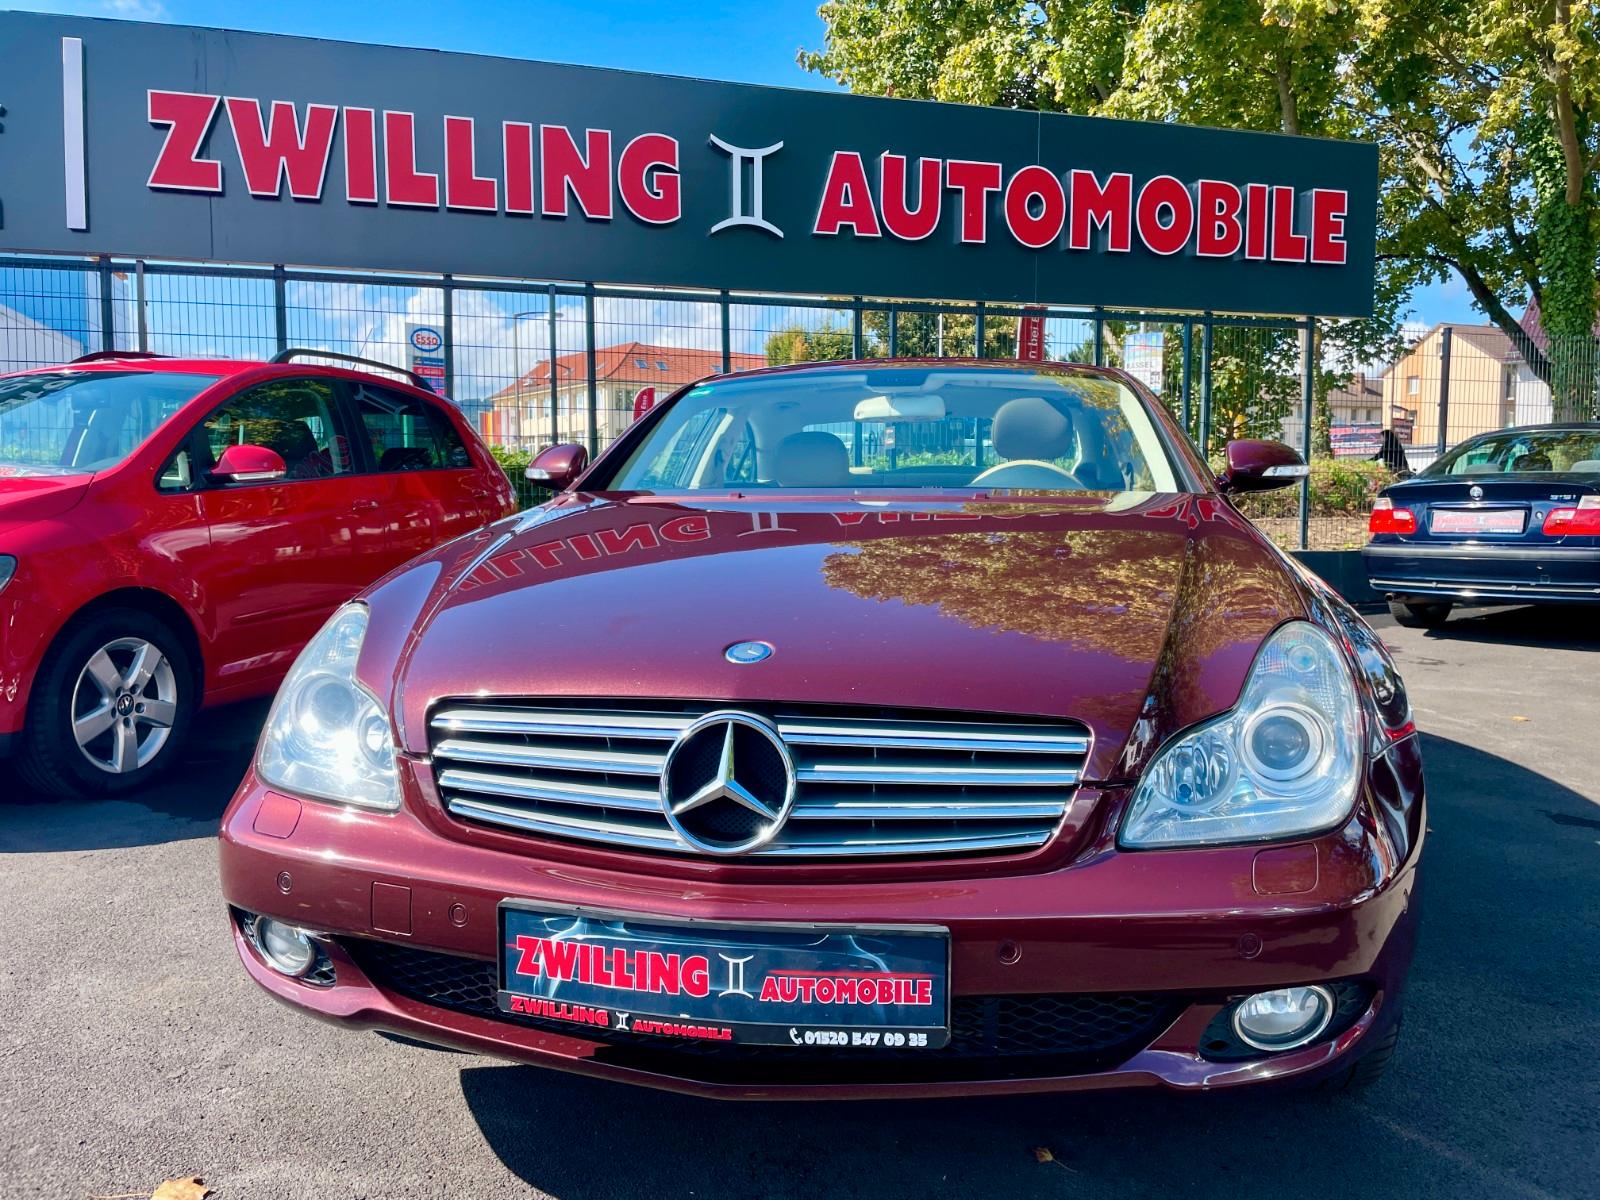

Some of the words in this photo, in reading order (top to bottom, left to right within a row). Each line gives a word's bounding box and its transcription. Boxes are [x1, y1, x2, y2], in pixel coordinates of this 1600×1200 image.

[146, 88, 682, 225] ZWILLING
[812, 149, 1349, 265] AUTOMOBILE
[415, 333, 438, 346] Esso
[515, 934, 710, 998] ZWILLING
[759, 975, 933, 1006] AUTOMOBILE
[510, 995, 609, 1026] ZWILLING
[632, 1019, 732, 1041] AUTOMOBILE
[804, 1031, 849, 1045] 01520
[852, 1032, 881, 1046] 547
[884, 1033, 906, 1047] 09
[909, 1033, 928, 1047] 35
